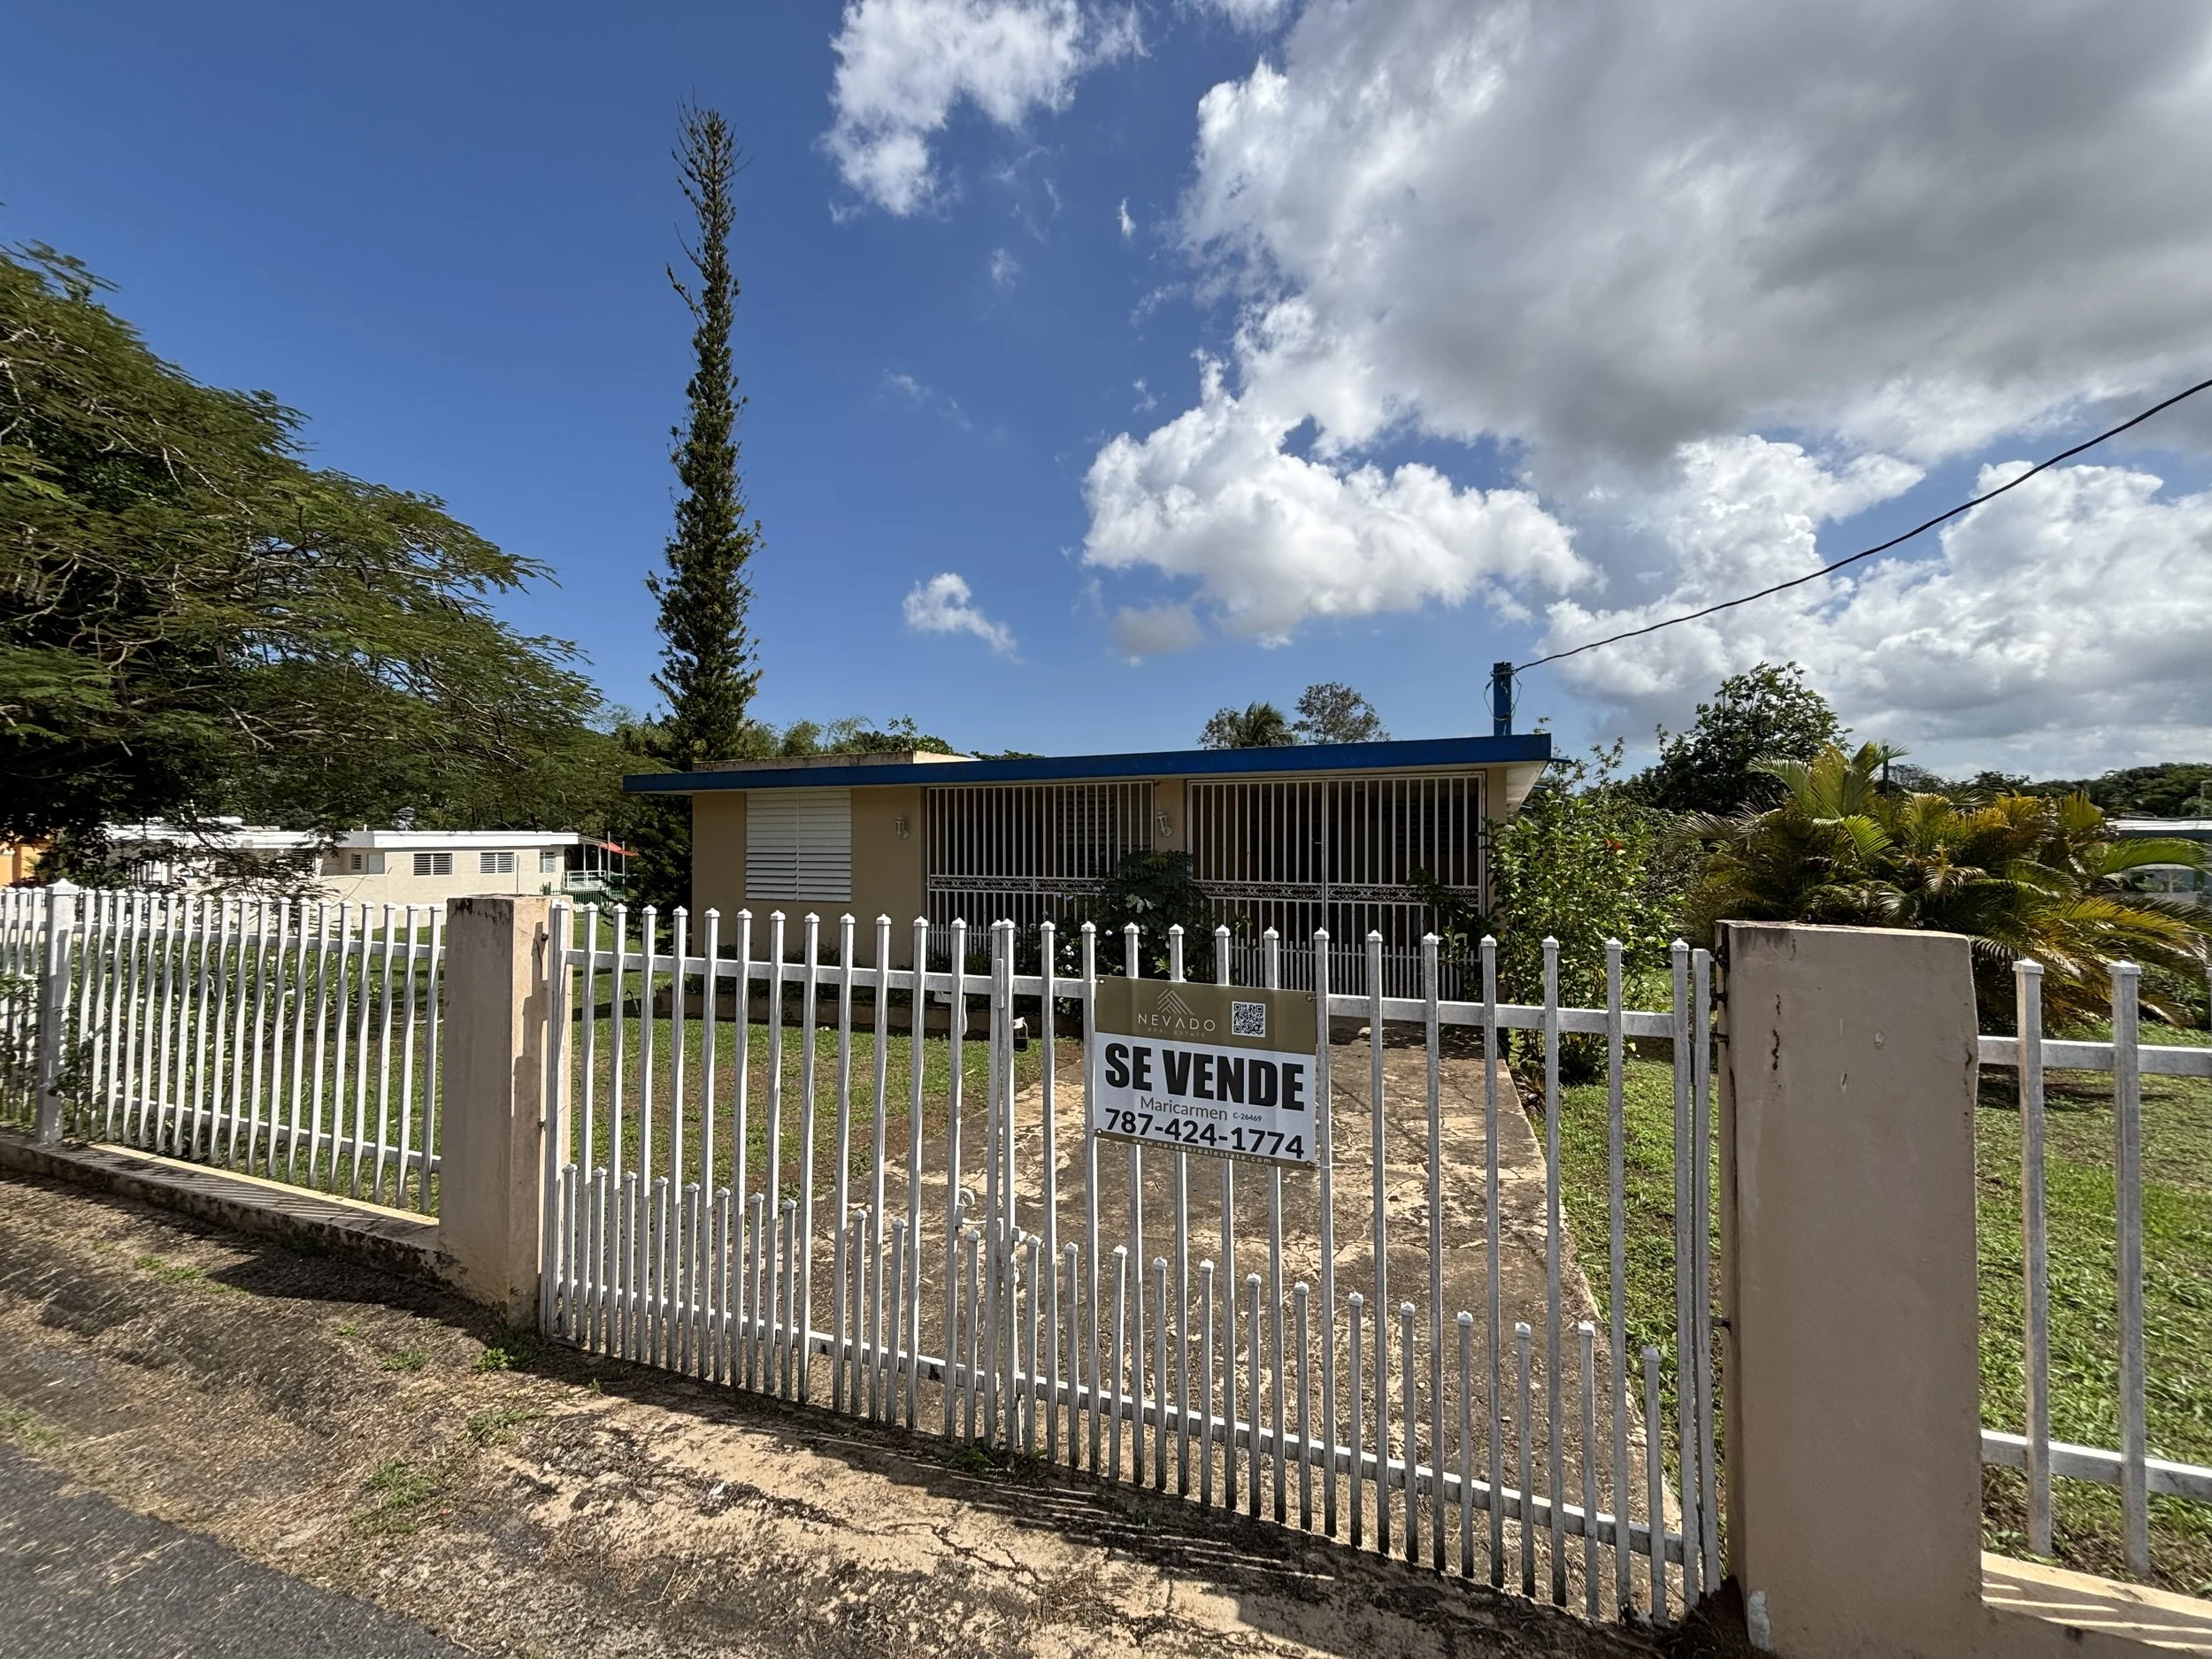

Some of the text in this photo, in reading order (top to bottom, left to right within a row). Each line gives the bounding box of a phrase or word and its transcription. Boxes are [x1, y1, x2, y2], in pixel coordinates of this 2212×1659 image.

[1138, 1013, 1216, 1032] NEVADO
[1105, 1043, 1305, 1112] SE VENDE
[1141, 1096, 1262, 1123] Maricarmen C-26469
[1105, 1109, 1304, 1159] 787-424-1774
[1132, 1139, 1271, 1164] www.nevadorealestate.com
